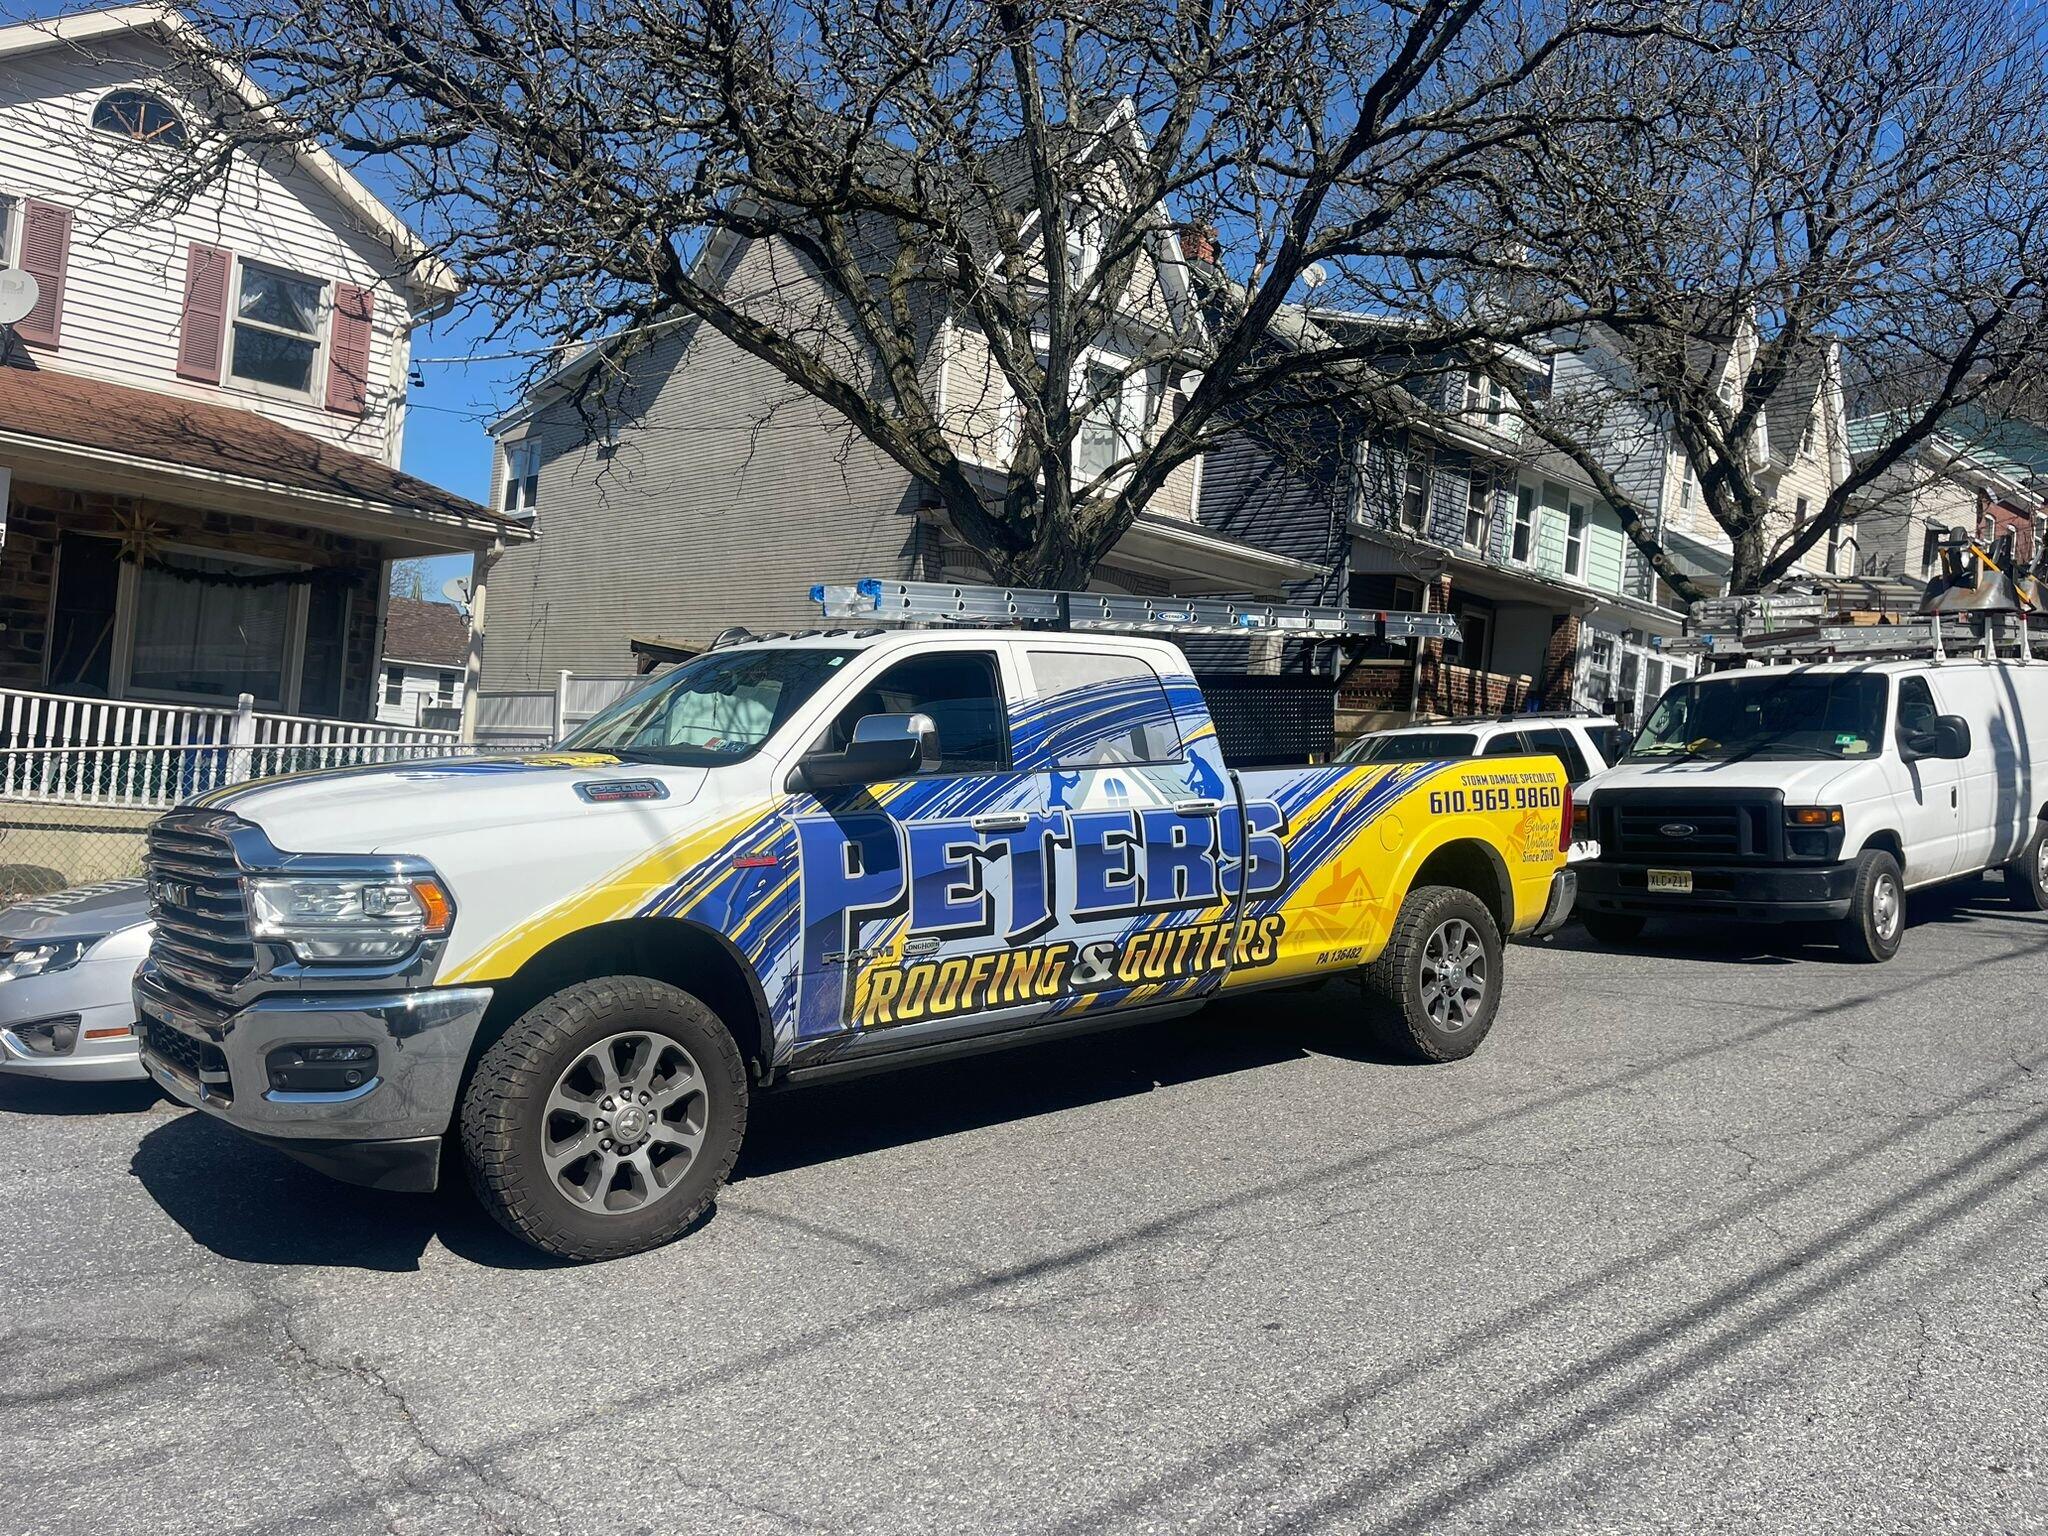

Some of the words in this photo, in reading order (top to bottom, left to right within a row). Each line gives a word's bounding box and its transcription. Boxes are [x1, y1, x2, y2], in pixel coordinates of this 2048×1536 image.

[1461, 775, 1488, 787] STORM
[1489, 774, 1518, 785] DAMAGE
[1519, 772, 1557, 784] SPECIALIST
[1430, 786, 1560, 814] 610.969.9860
[1522, 850, 1540, 863] Since
[781, 798, 1290, 1044] PETERS
[822, 945, 894, 965] RAM
[1315, 952, 1330, 966] PA
[863, 943, 1070, 1027] ROOFING
[1068, 943, 1115, 984] &
[1119, 916, 1282, 983] GUTTERS
